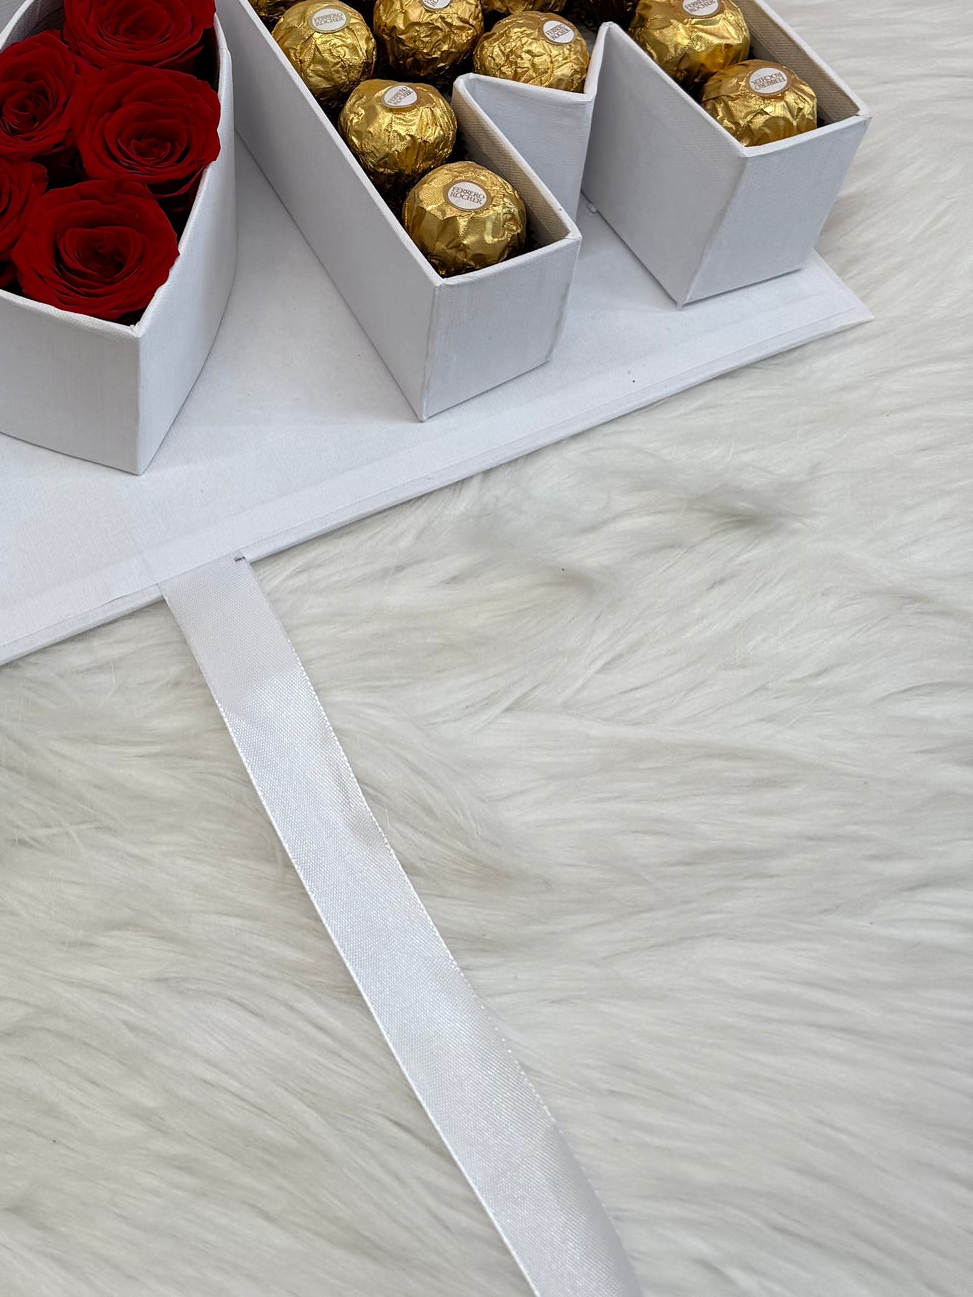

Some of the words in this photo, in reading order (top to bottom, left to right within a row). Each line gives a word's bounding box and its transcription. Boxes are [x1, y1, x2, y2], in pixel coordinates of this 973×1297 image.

[751, 72, 782, 85] ROCHER
[755, 76, 785, 90] FERRERO
[450, 192, 482, 204] ROCHER
[452, 187, 485, 199] FERRERO
